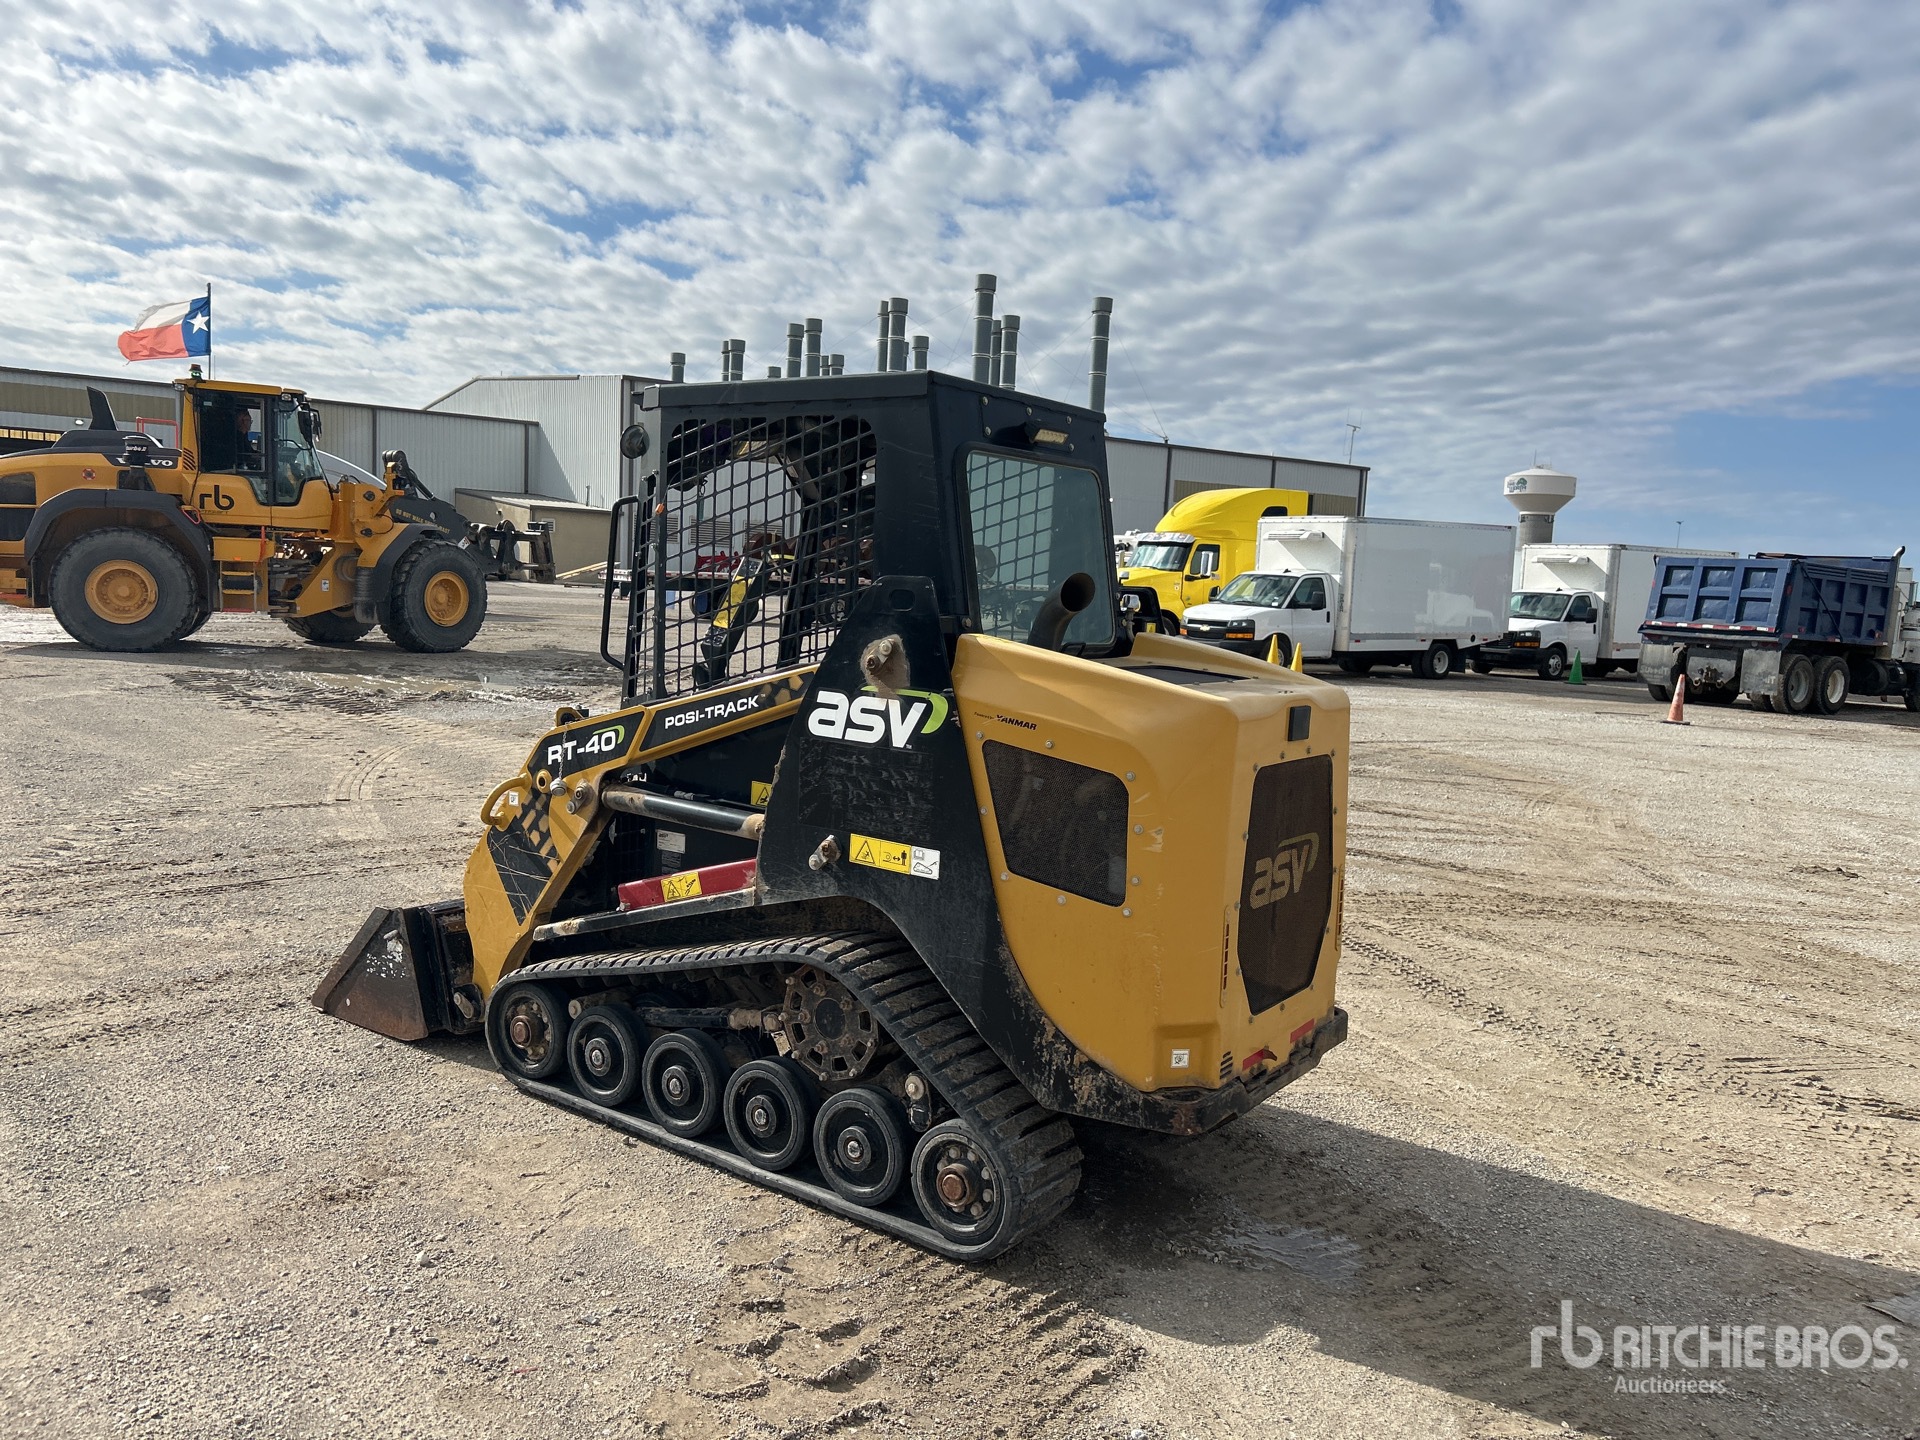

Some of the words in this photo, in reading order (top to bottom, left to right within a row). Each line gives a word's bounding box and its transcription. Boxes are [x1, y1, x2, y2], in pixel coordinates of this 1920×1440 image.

[199, 485, 235, 510] rb
[665, 695, 759, 729] POSI-TRACK
[997, 715, 1038, 730] YANMAR
[547, 731, 616, 765] RT-40
